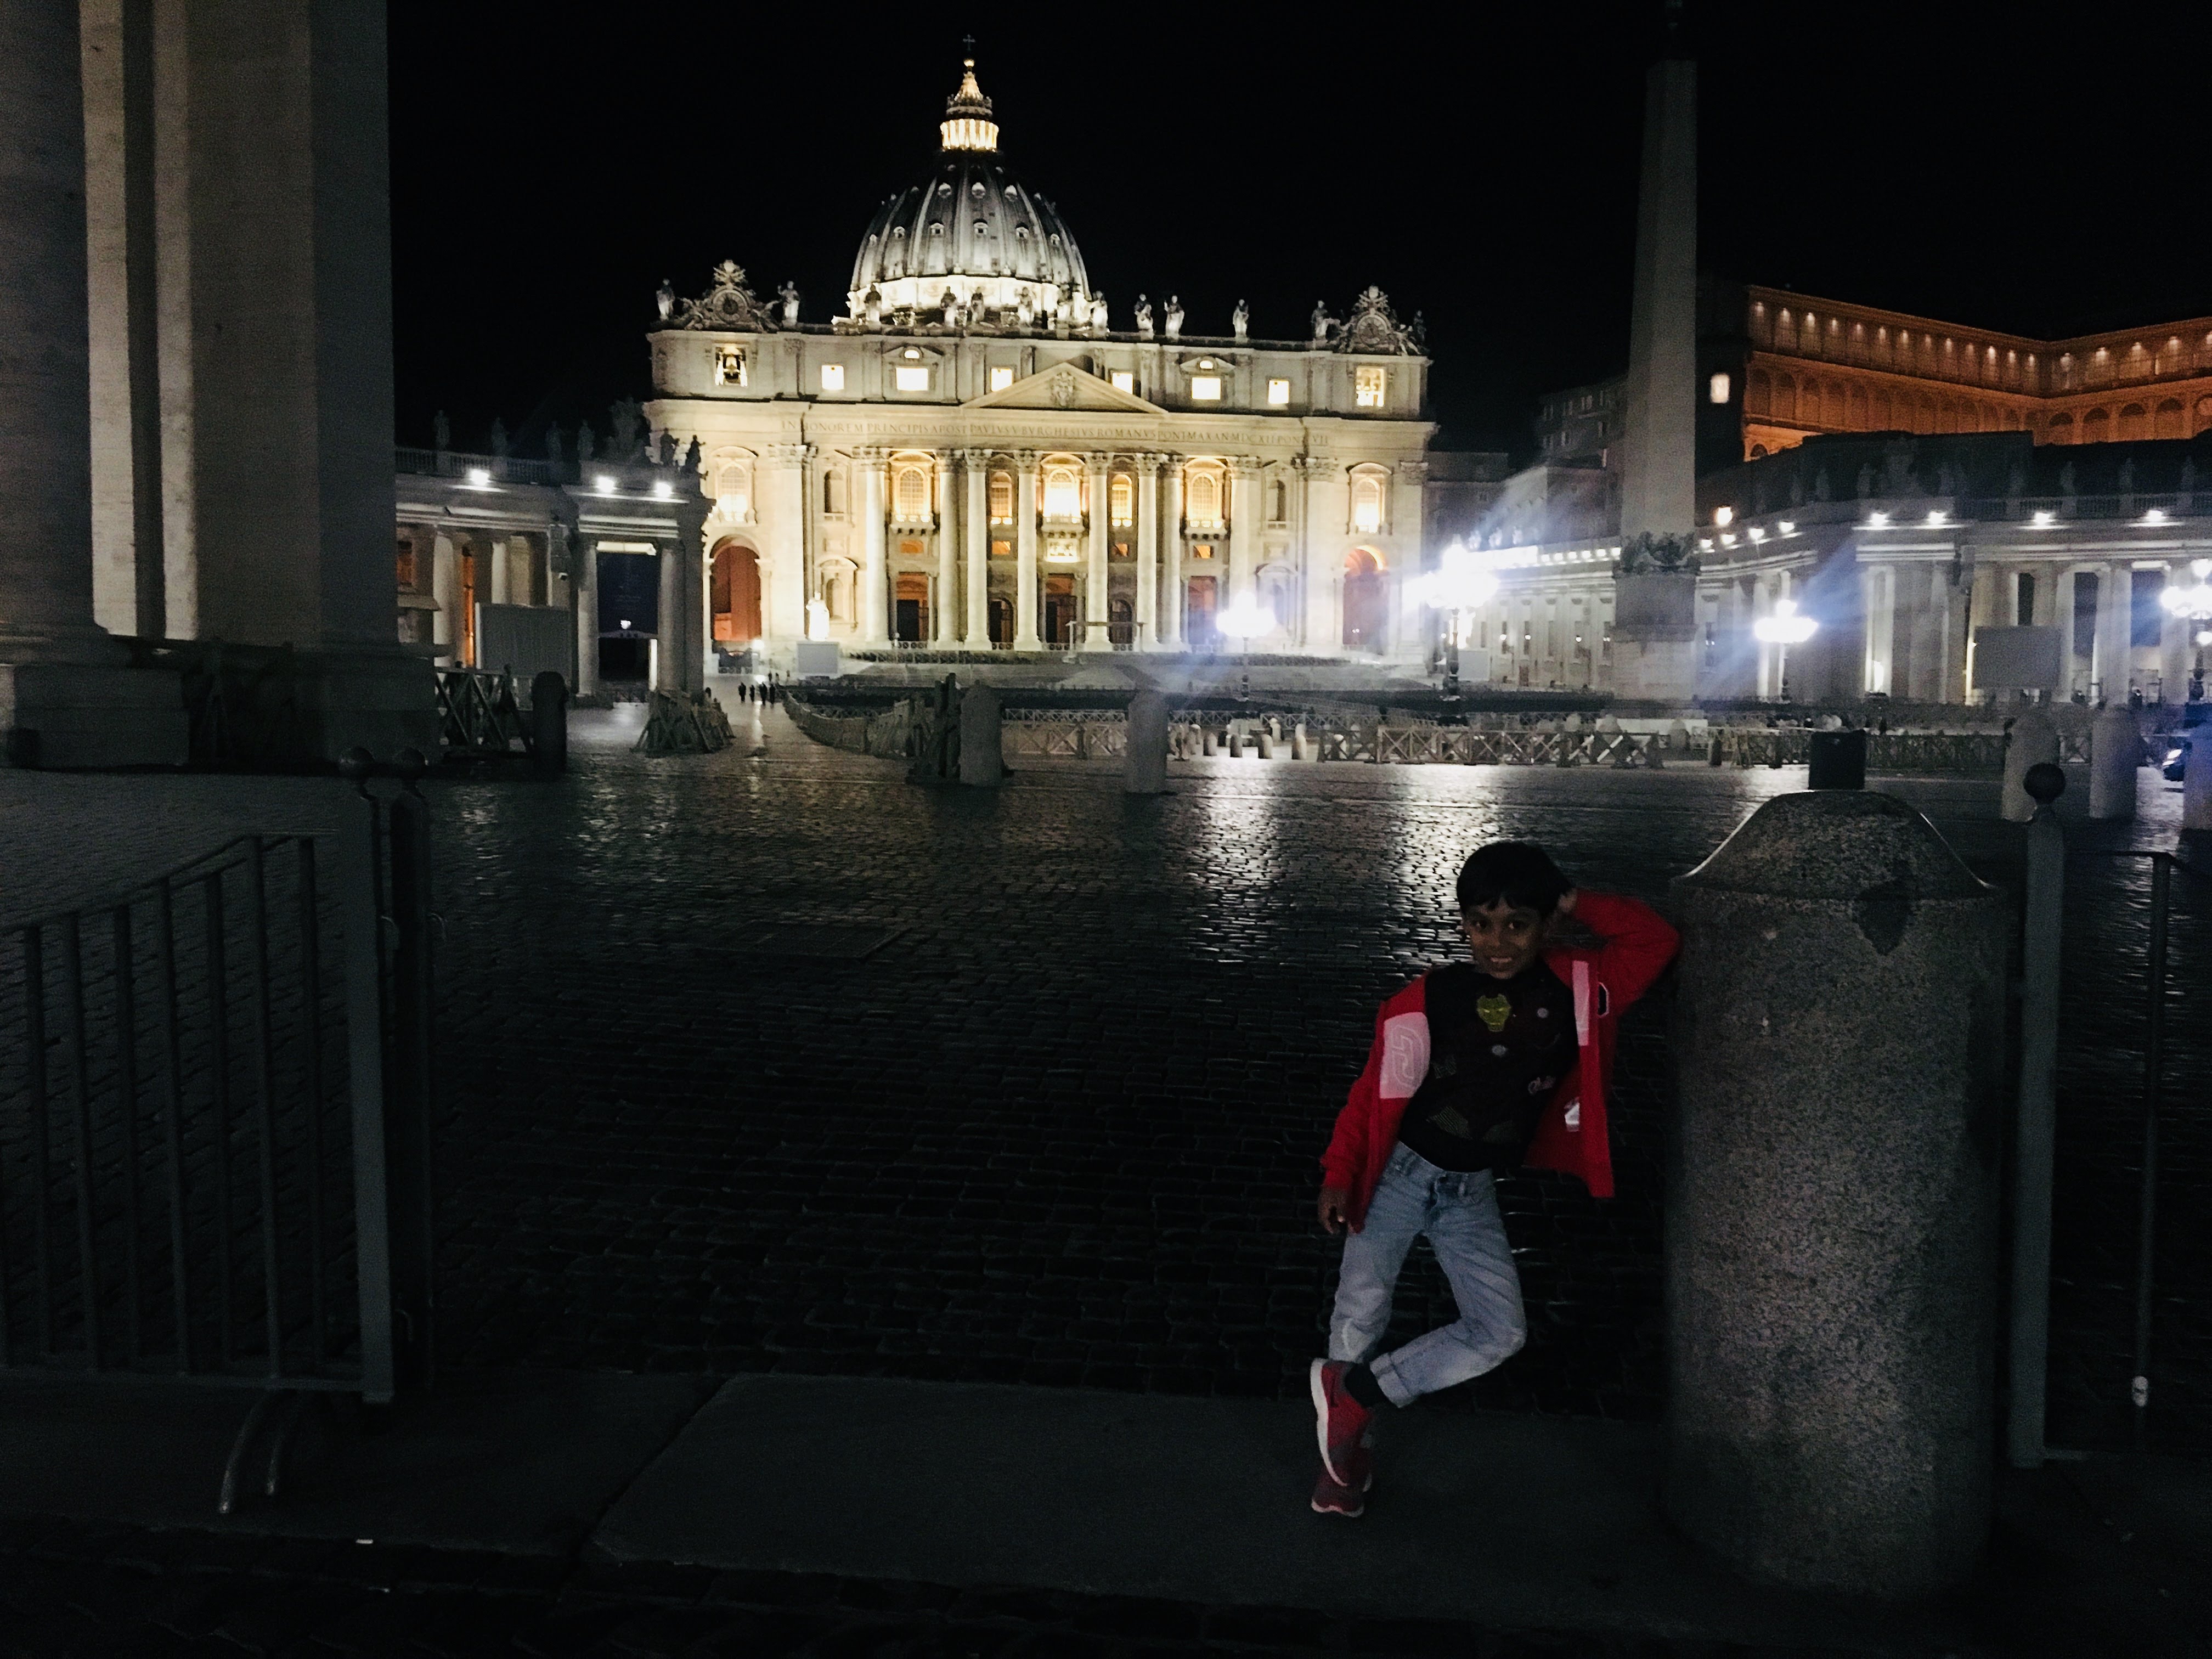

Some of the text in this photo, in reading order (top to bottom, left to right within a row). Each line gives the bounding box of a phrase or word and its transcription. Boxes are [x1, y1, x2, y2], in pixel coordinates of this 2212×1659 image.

[781, 420, 797, 430] IN
[867, 423, 929, 433] PRINCIPIS
[932, 424, 967, 434] APOST
[1097, 428, 1156, 438] ROMANVS
